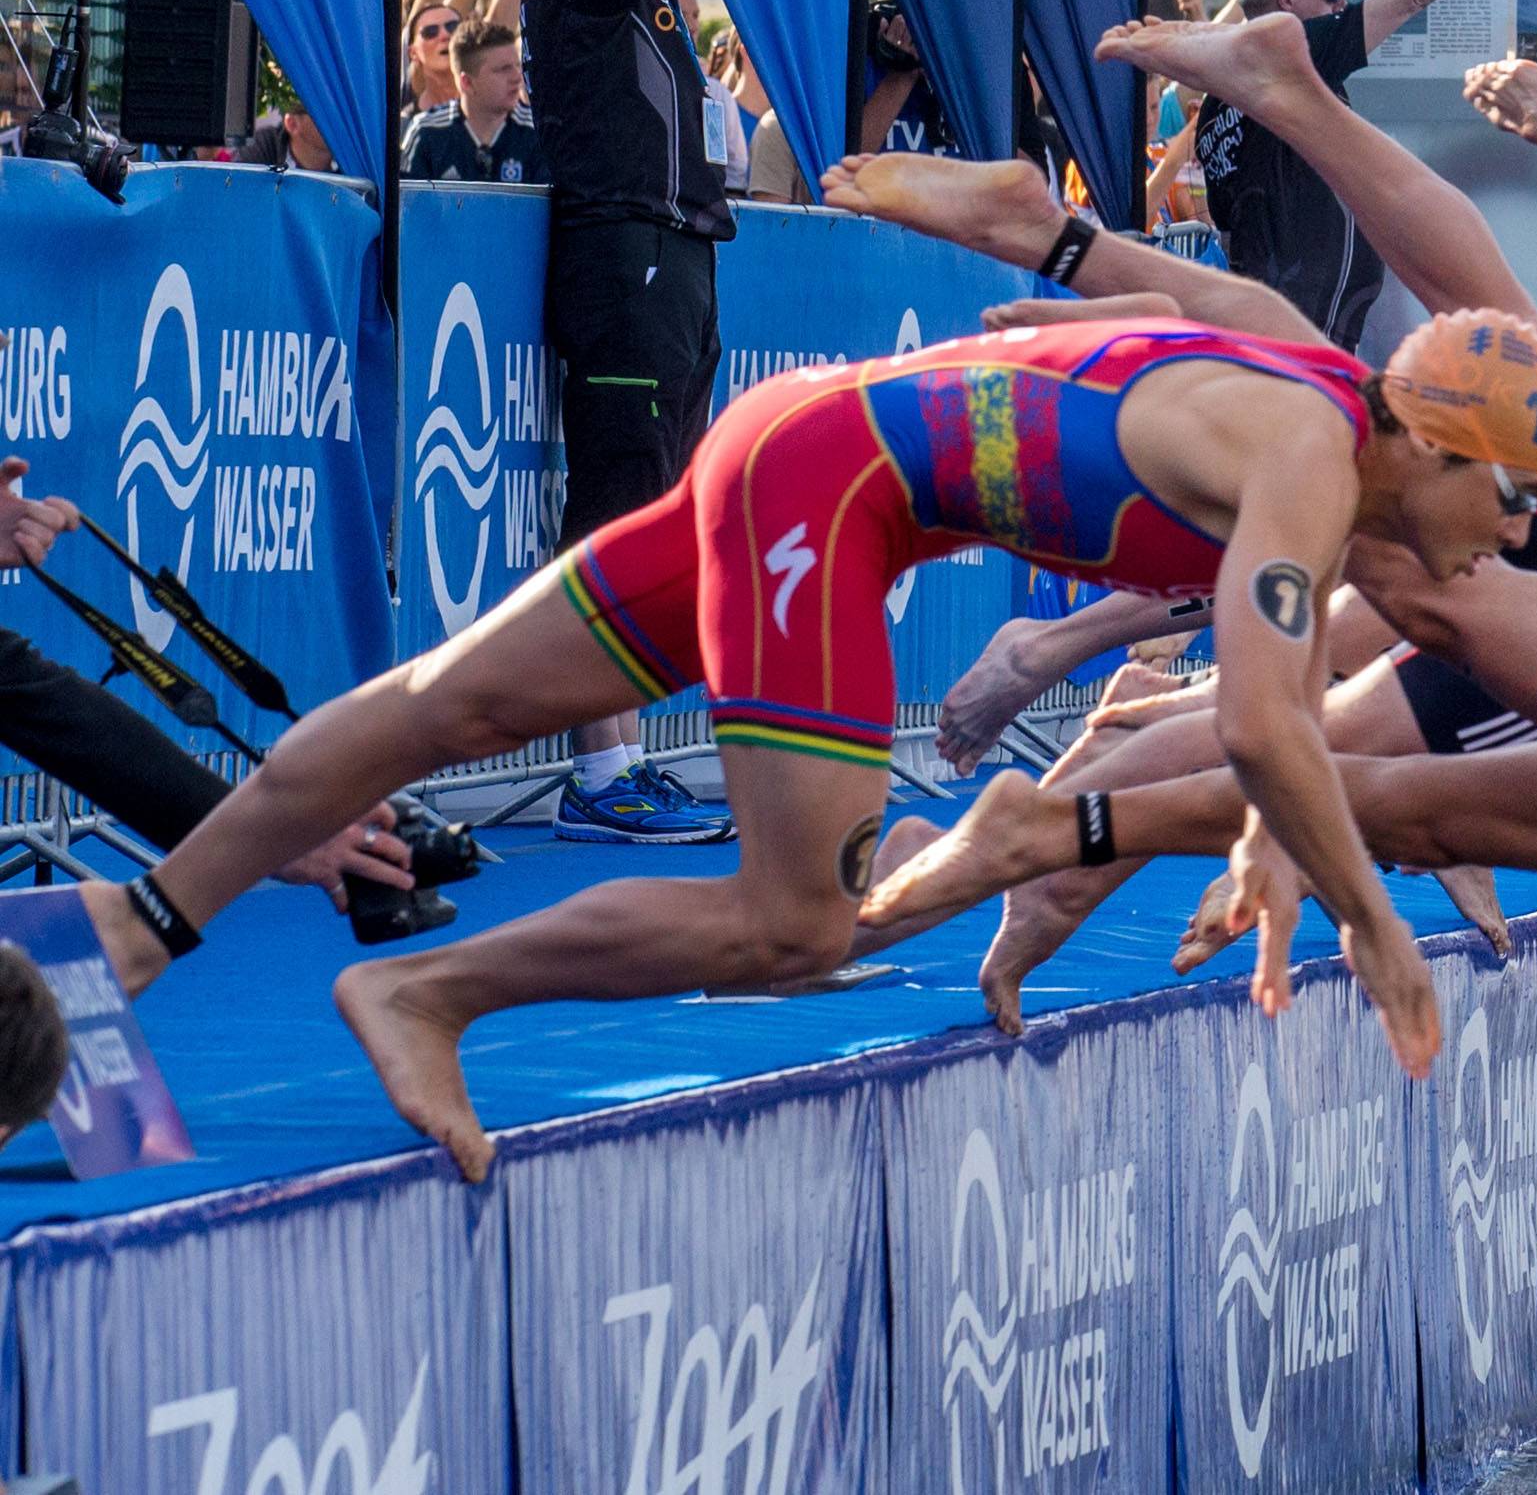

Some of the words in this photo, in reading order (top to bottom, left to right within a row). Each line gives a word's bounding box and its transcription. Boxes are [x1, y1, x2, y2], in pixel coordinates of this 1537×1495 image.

[213, 464, 315, 573] WASSER
[1286, 1094, 1385, 1231] HAMBURG
[1019, 1162, 1136, 1317] HAMBURG
[1283, 1243, 1360, 1376] WASSER
[1020, 1330, 1109, 1478] WASSER
